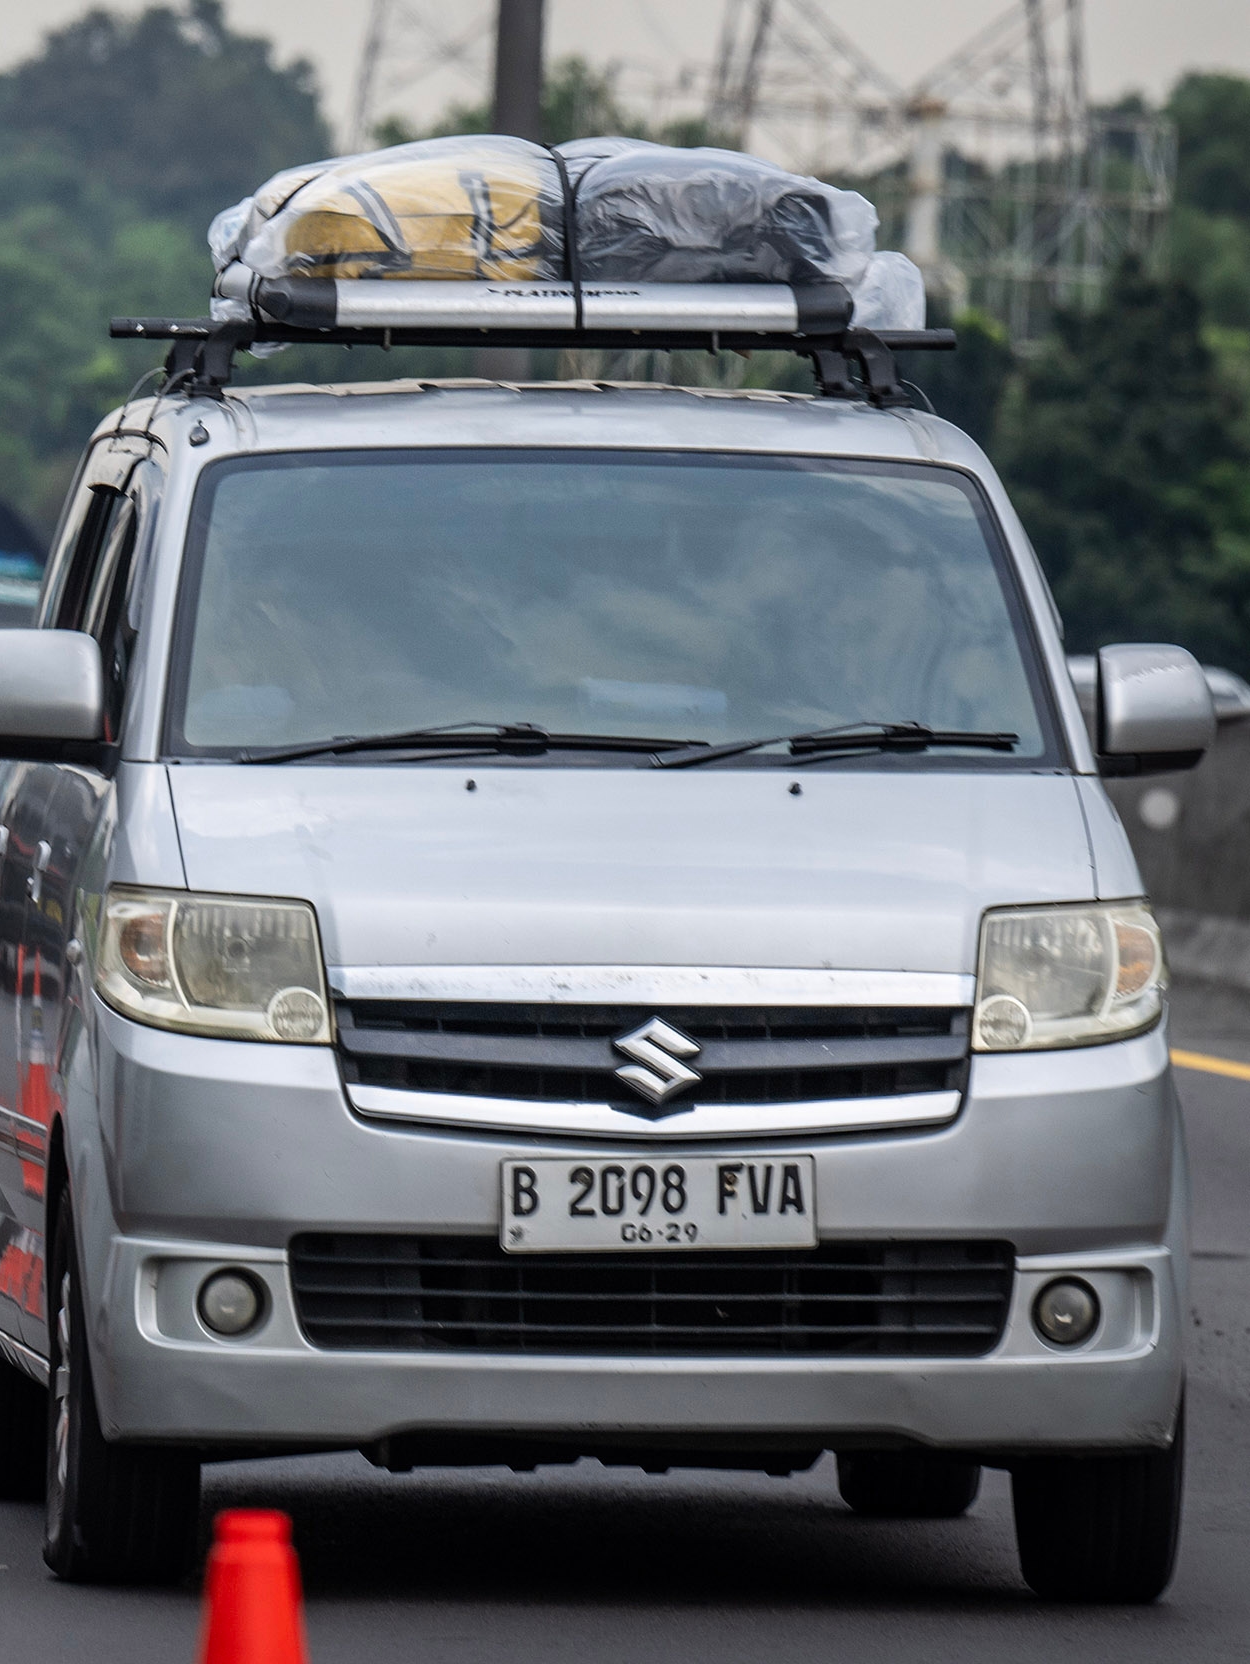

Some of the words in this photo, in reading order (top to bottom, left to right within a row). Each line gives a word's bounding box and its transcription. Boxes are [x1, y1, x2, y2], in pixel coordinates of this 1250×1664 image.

[504, 289, 601, 298] PLATINM
[512, 1165, 538, 1217] B
[569, 1163, 687, 1217] 2098
[717, 1162, 805, 1214] FVA
